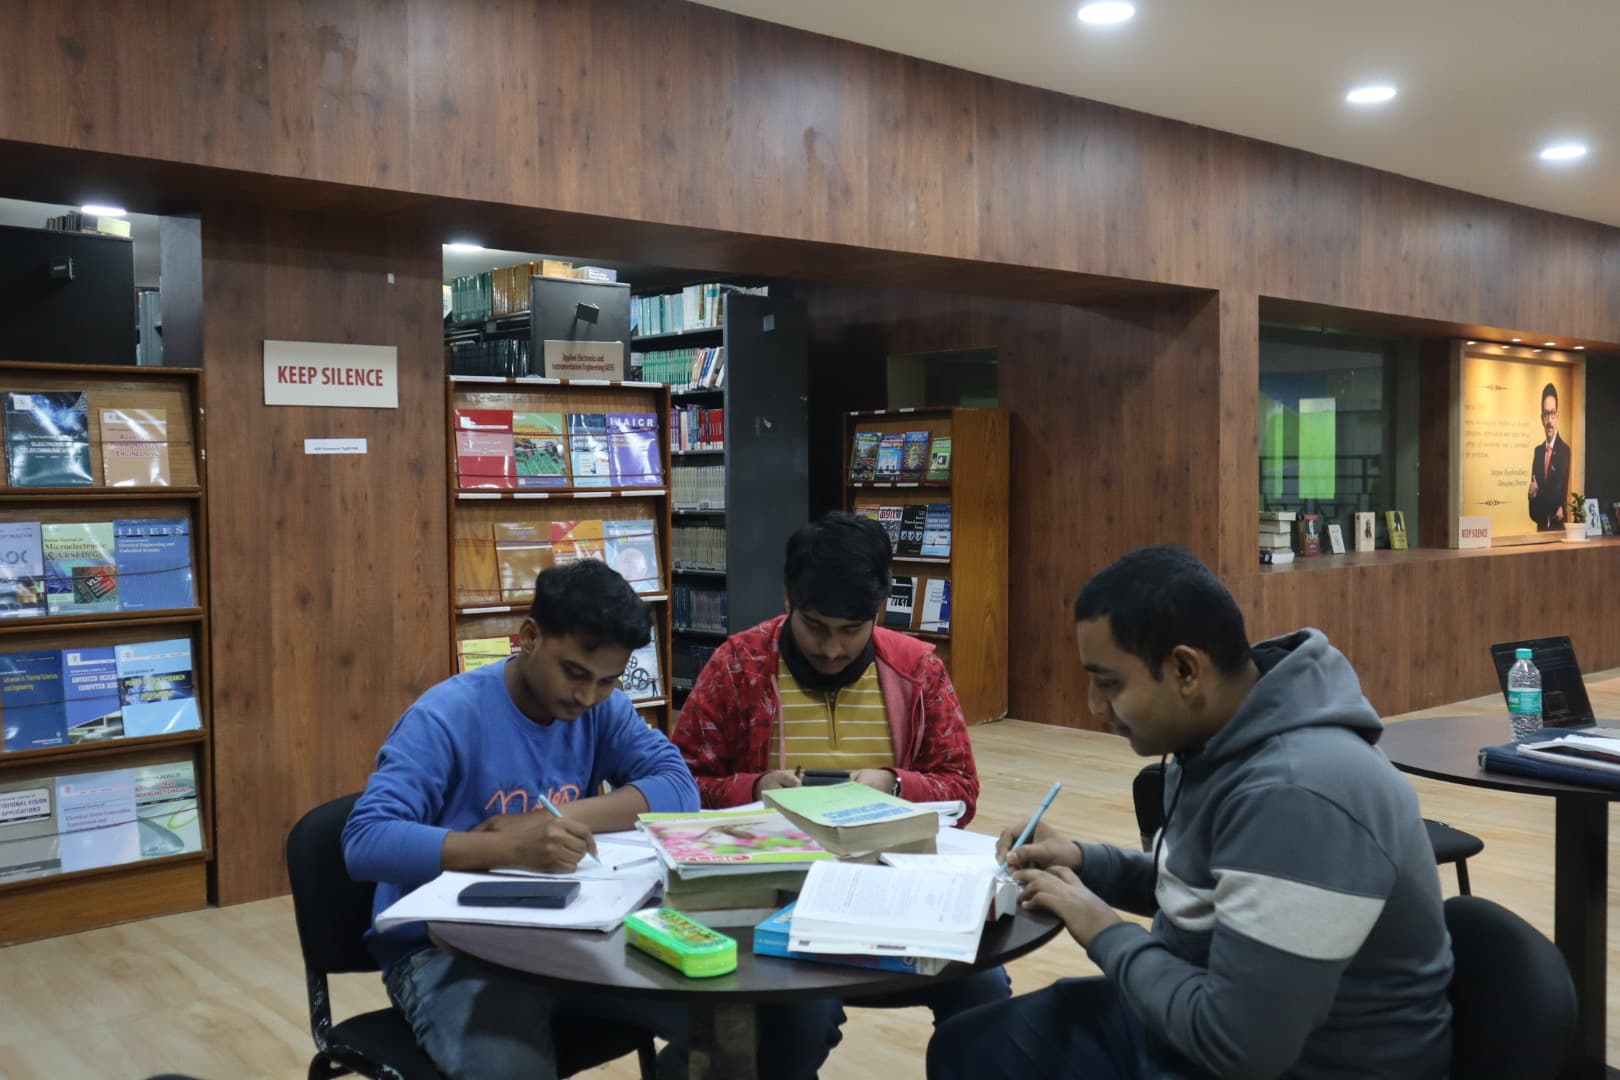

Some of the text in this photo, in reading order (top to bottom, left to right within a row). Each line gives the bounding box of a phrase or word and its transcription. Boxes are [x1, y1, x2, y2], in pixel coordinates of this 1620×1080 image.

[277, 365, 384, 387] KEEP SILENCE
[1461, 528, 1488, 538] KEEP SILENCE
